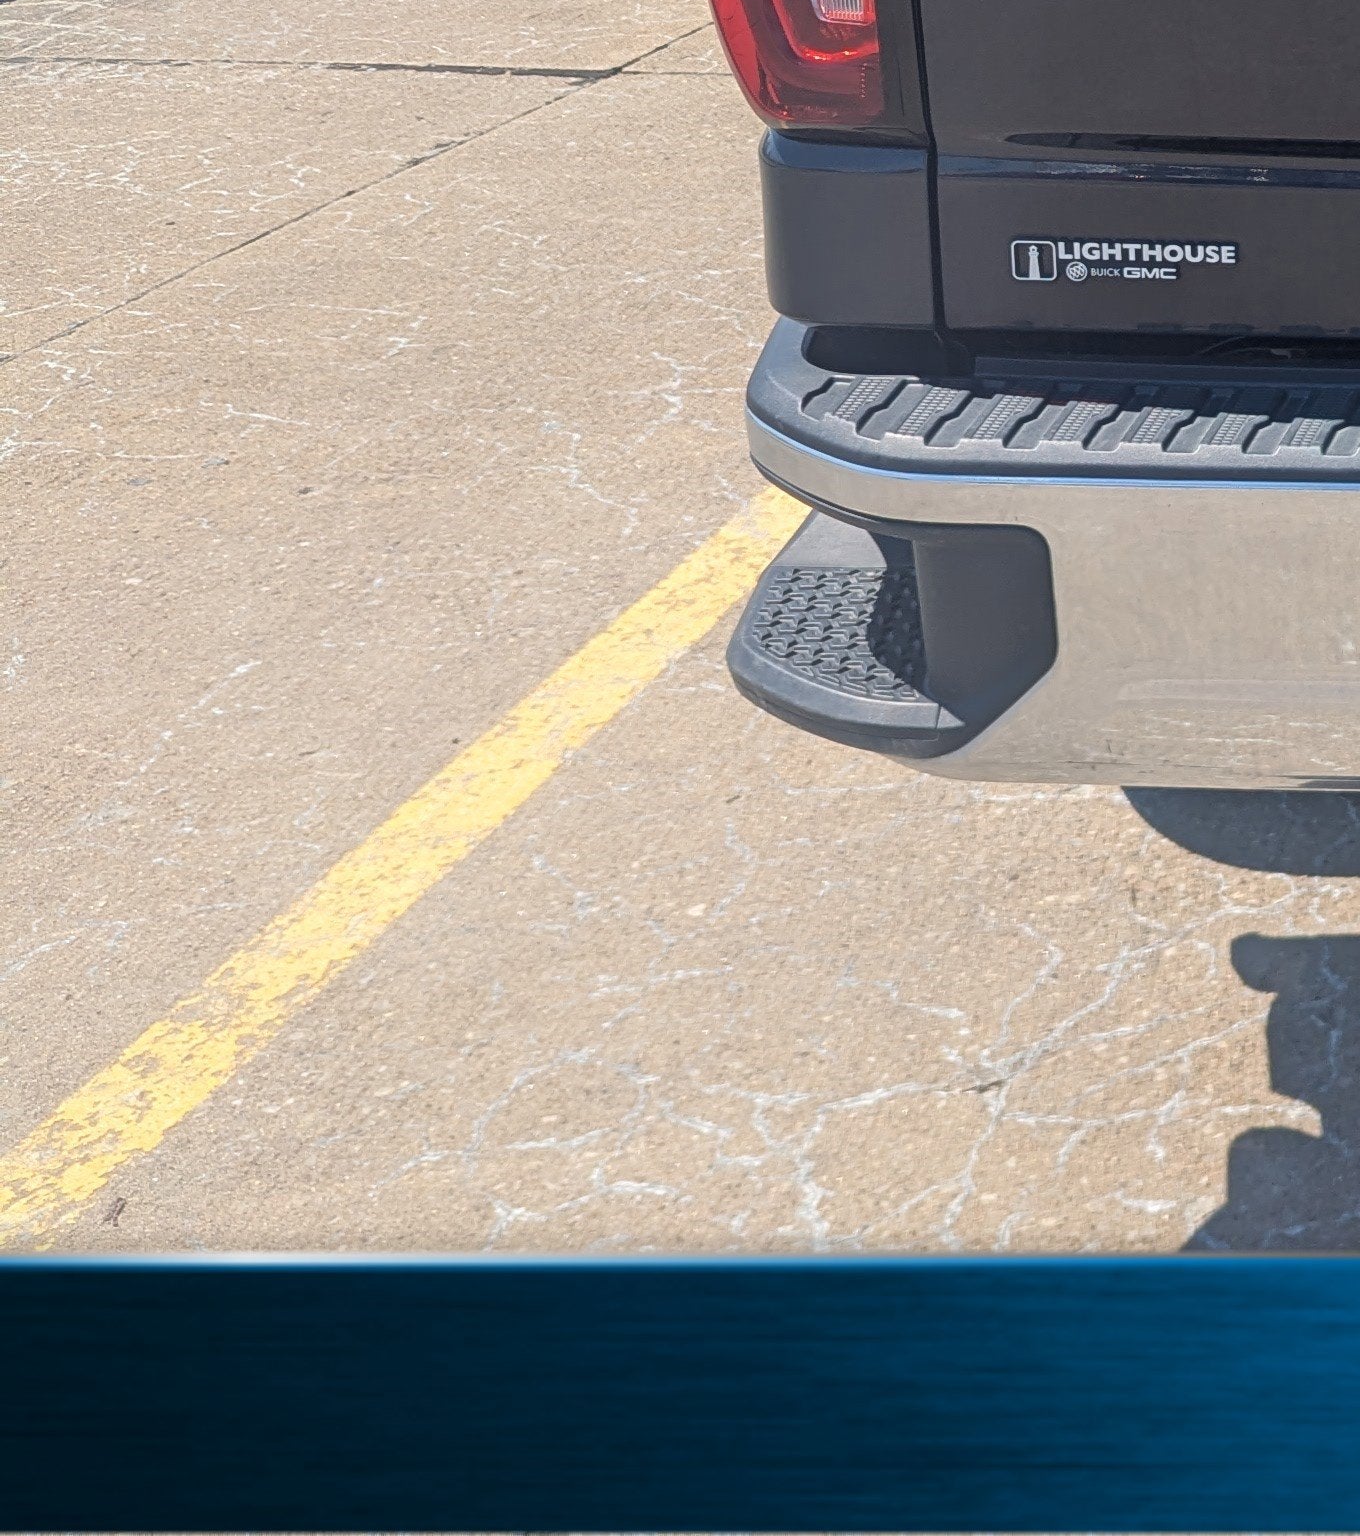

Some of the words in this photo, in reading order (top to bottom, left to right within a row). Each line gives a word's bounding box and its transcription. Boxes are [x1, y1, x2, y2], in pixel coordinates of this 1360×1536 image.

[1057, 241, 1236, 264] LIGHTHOUSE
[1090, 266, 1121, 278] BUICK
[1123, 266, 1178, 280] GMC
